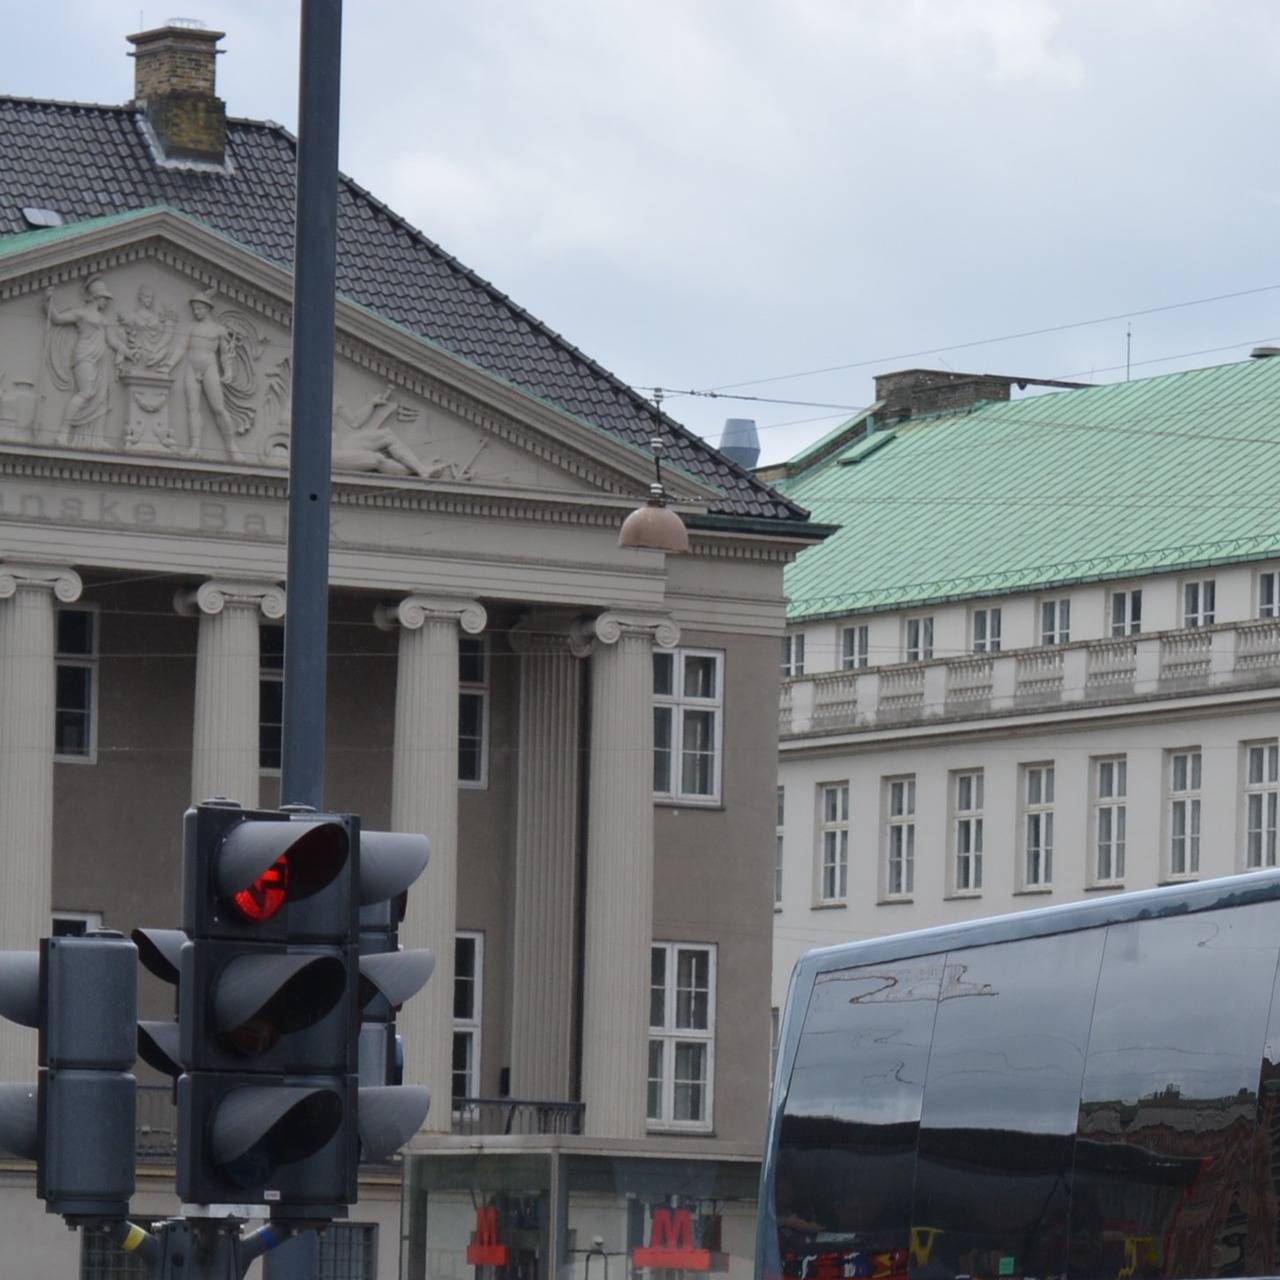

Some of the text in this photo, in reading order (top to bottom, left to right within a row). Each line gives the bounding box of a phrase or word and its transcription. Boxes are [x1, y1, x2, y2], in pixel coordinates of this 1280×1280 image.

[0, 490, 342, 541] nske Bak
[650, 1207, 695, 1250] M
